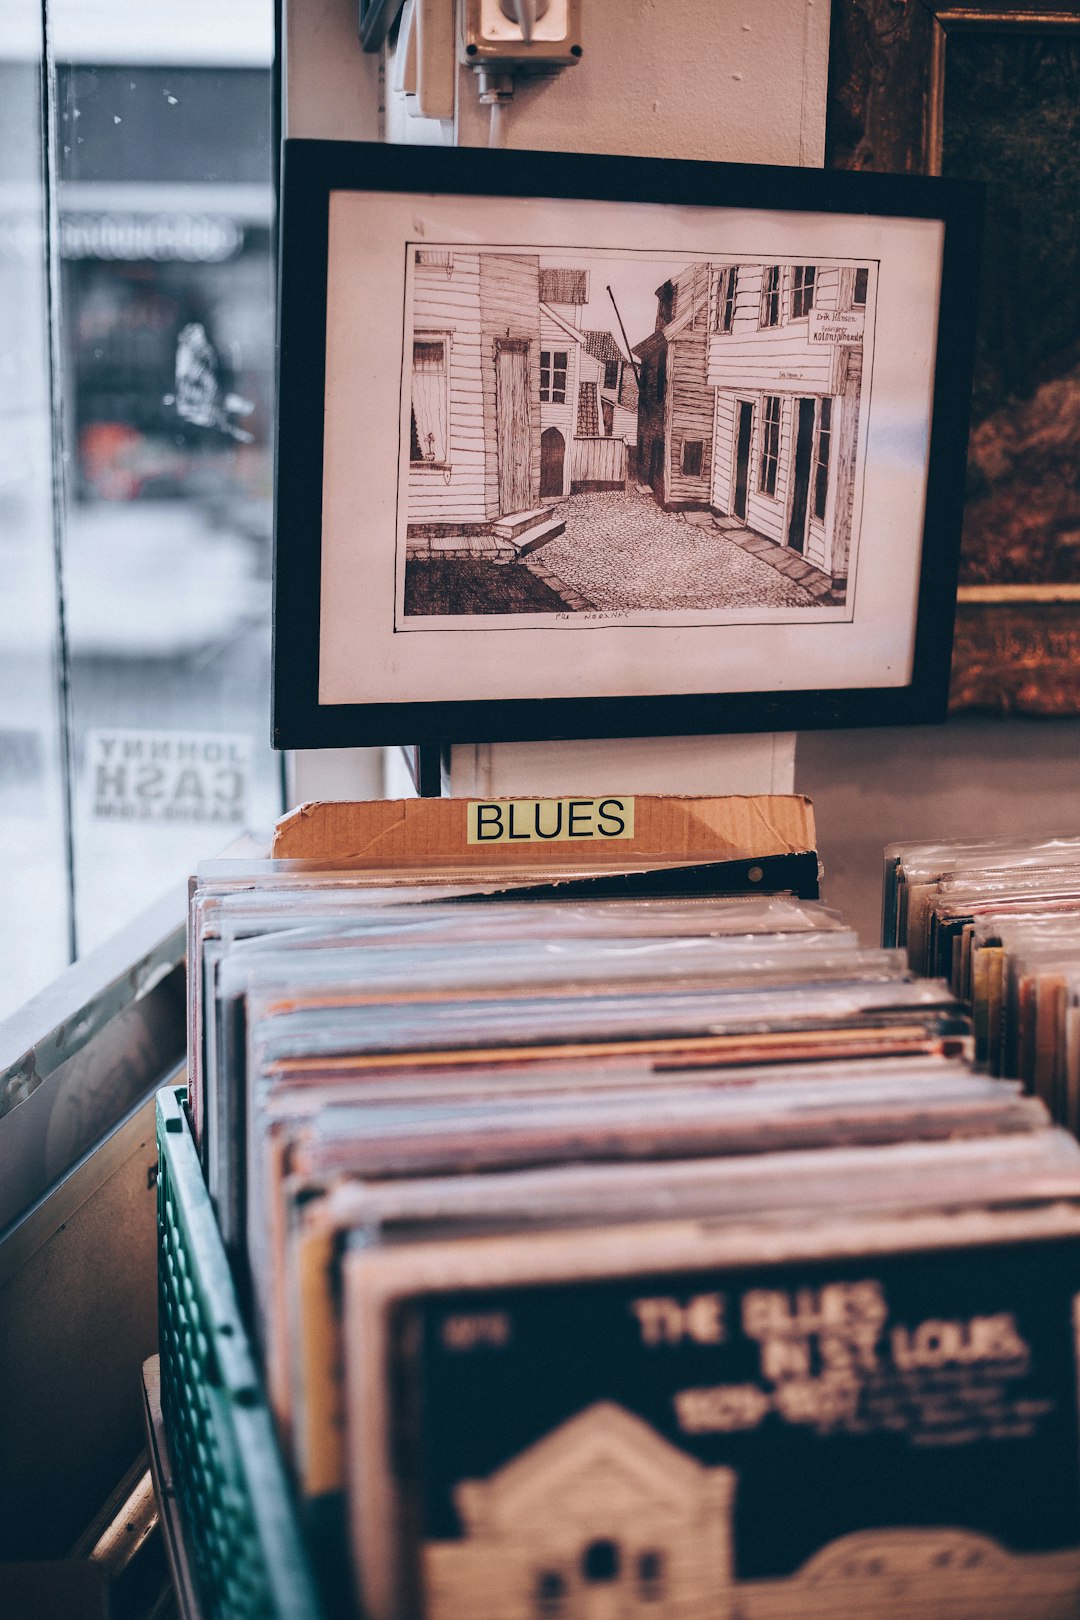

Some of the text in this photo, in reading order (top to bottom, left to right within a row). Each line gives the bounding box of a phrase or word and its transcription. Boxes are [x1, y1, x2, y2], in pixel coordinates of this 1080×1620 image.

[477, 799, 625, 840] BLUES
[635, 1281, 887, 1346] THE BLUES
